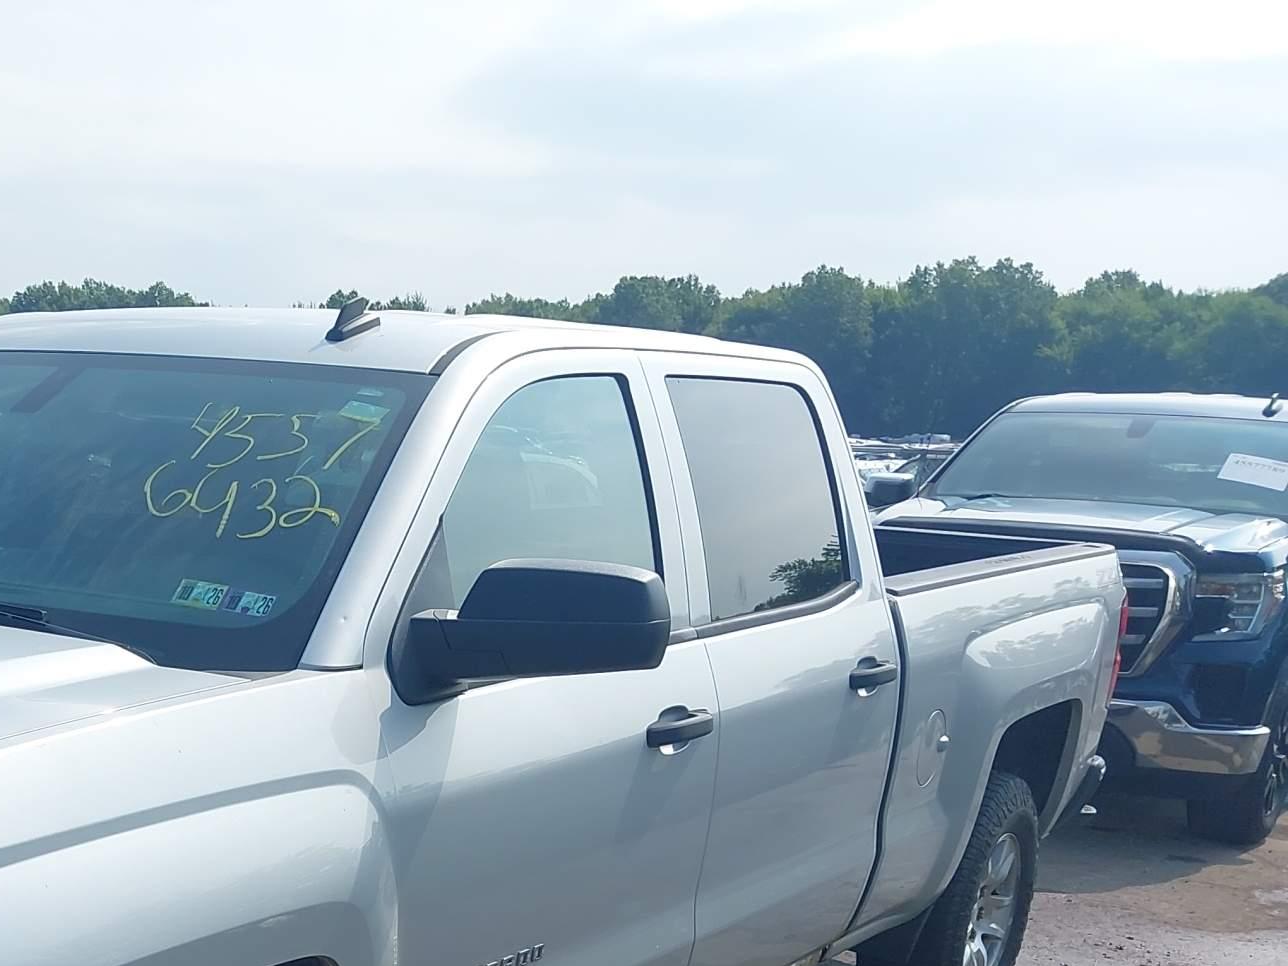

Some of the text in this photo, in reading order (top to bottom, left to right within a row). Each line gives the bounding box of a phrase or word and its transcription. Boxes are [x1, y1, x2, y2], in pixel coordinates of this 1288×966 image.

[190, 401, 381, 471] 4557
[144, 459, 341, 539] 6432
[205, 587, 225, 606] 26
[256, 596, 274, 616] 26
